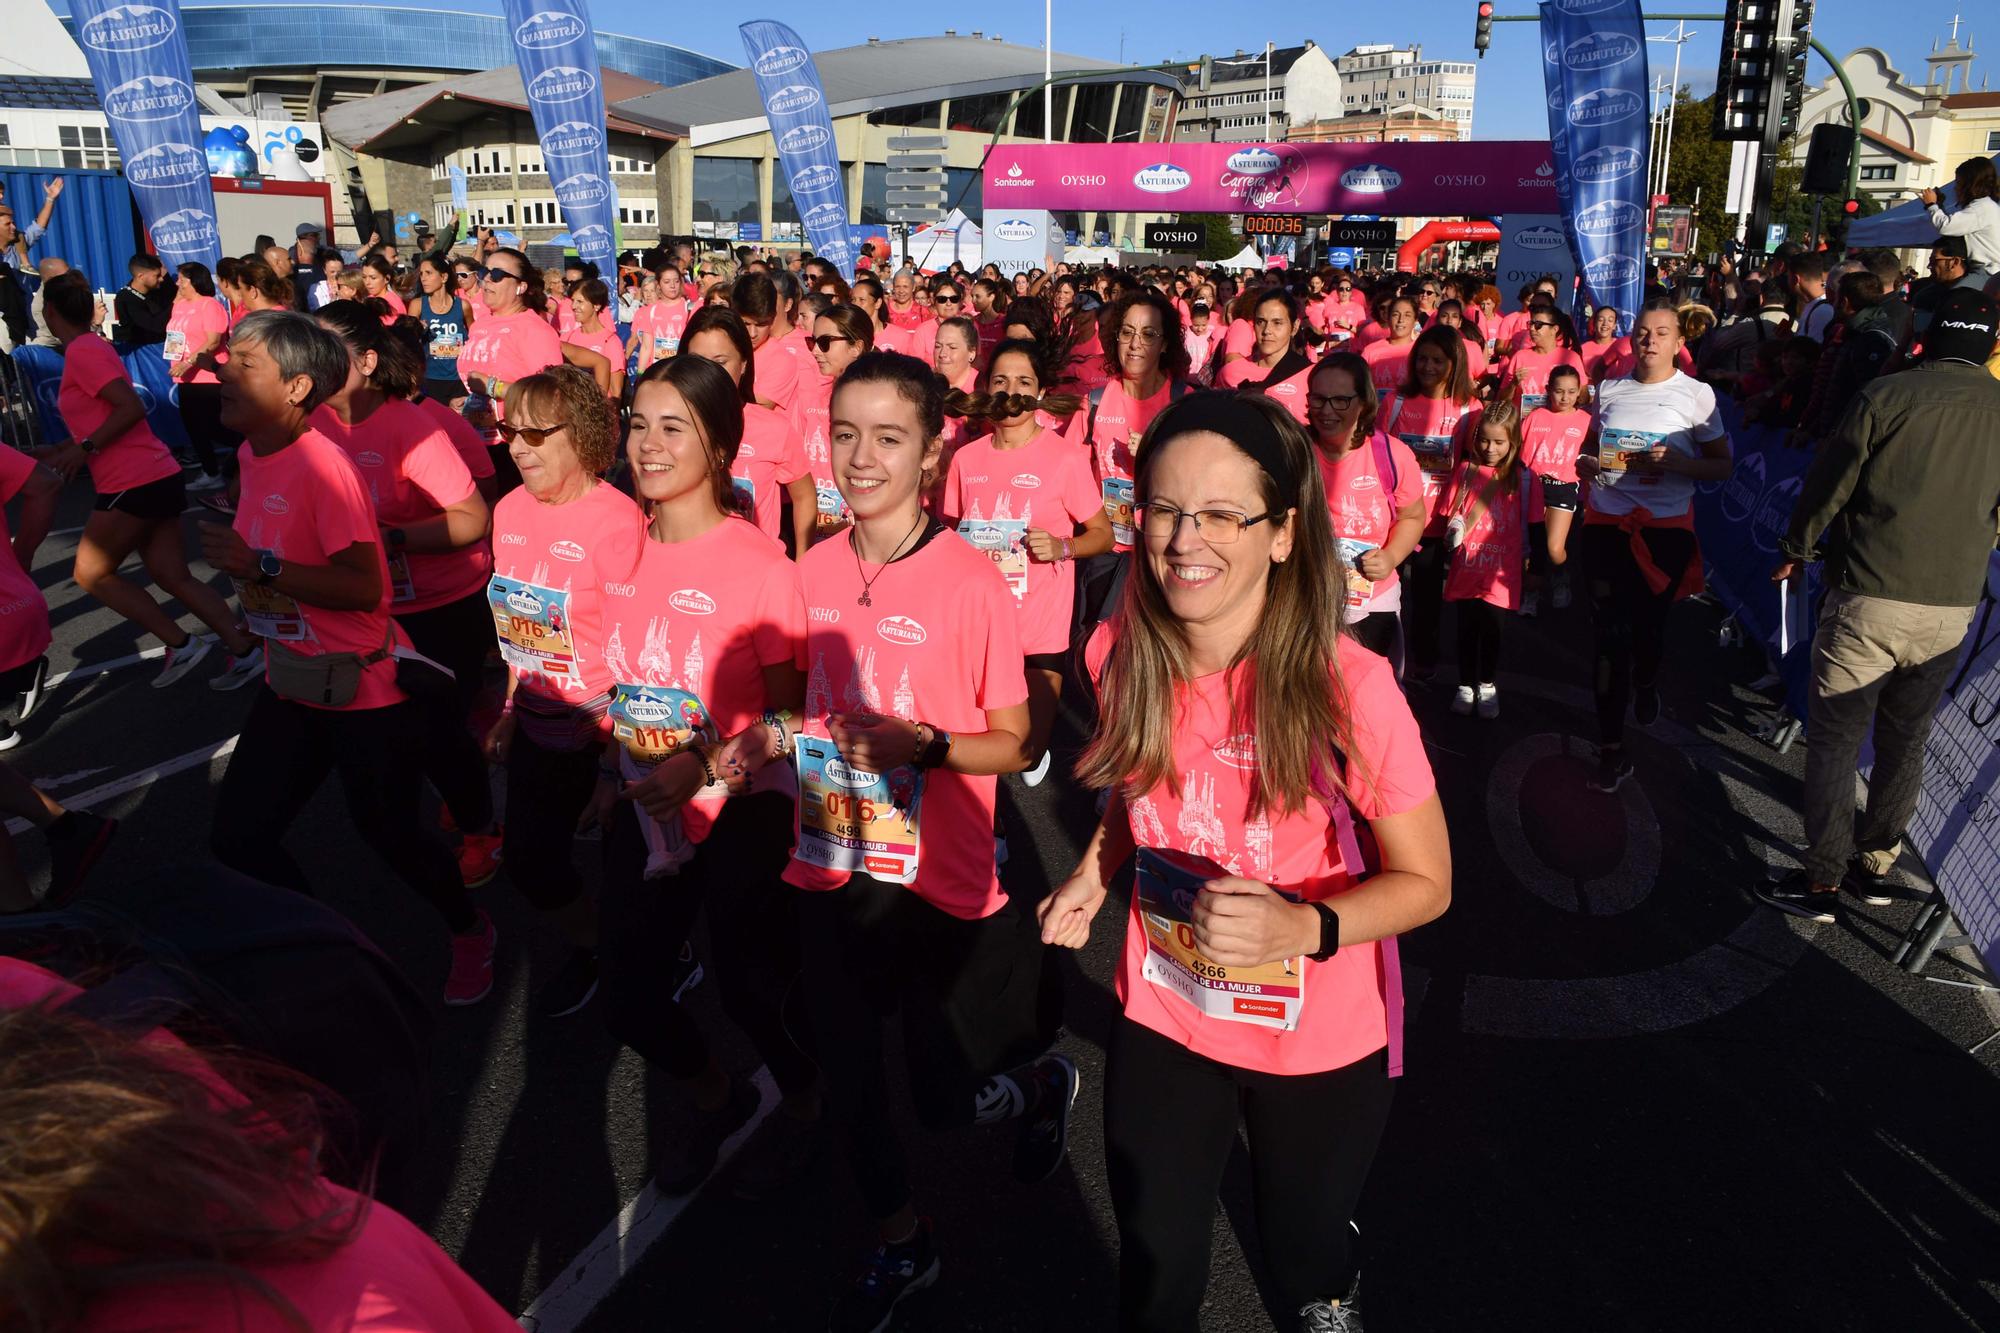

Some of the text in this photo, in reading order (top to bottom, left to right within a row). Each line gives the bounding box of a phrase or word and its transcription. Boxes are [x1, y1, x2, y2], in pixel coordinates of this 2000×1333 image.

[1230, 154, 1278, 168] ASTURIANA
[994, 177, 1035, 187] Santander
[1061, 175, 1106, 186] OYSHO
[1137, 171, 1187, 185] ASTURIANA
[1220, 172, 1266, 188] Carrera
[1343, 173, 1397, 187] ASTURIANA
[1434, 174, 1486, 186] OYSHO
[1246, 184, 1283, 209] Mujer
[997, 226, 1033, 237] ASTURIANA
[1153, 231, 1197, 242] OYSHO
[1340, 229, 1387, 241] OYSHO
[1772, 224, 1785, 240] P
[1516, 234, 1564, 245] ASTURIANA
[992, 260, 1036, 271] OYSHO
[1941, 320, 1990, 333] MMR
[1096, 415, 1126, 424] OYSHO
[972, 532, 1002, 541] ASTURIANA
[552, 544, 583, 559] ASTURIANA
[982, 550, 1001, 563] 16
[605, 582, 636, 598] OYSHO
[671, 595, 712, 611] ASTURIANA
[511, 616, 543, 638] 016
[880, 622, 922, 641] ASTURIANA
[521, 638, 535, 647] 876
[627, 703, 670, 716] ASTURIANA
[635, 727, 678, 749] 016
[827, 763, 876, 783] ASTURIANA
[826, 791, 875, 822] 016
[836, 822, 861, 838] 4499
[806, 843, 835, 862] OYSHO
[850, 839, 860, 848] LA
[861, 841, 888, 852] MUJER
[1191, 959, 1226, 978] 4266
[1157, 963, 1194, 996] OYSHO
[1199, 977, 1210, 988] DE
[1213, 980, 1226, 990] LA
[1228, 982, 1262, 994] MUJER
[1248, 1004, 1279, 1013] Santander
